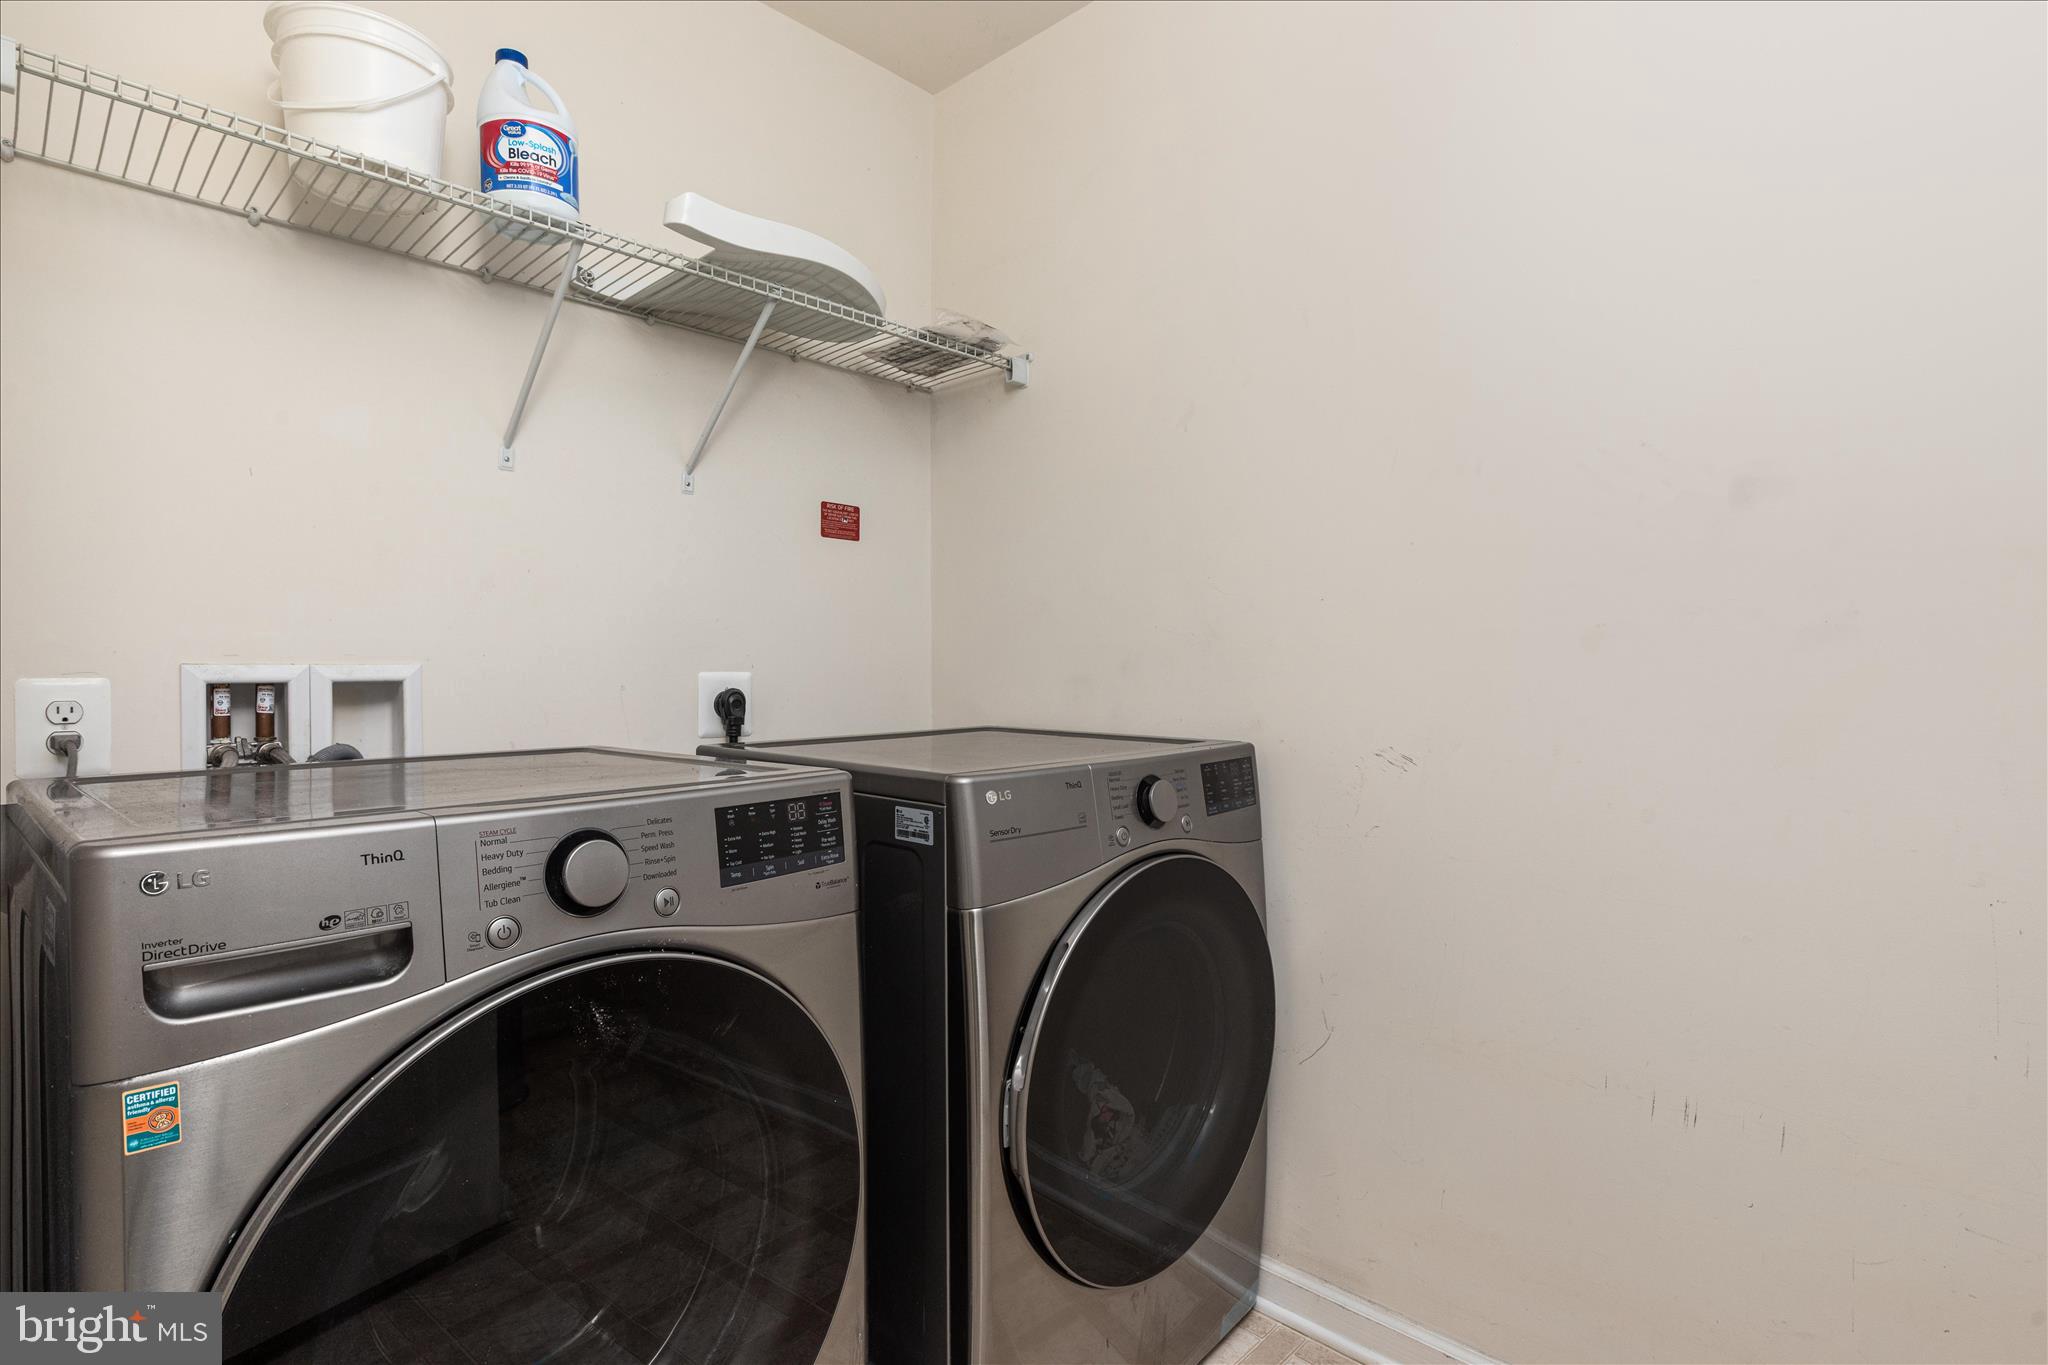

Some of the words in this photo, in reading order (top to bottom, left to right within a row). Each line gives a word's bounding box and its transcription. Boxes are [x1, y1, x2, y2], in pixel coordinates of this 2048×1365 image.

[508, 139, 557, 156] Low-Splash
[508, 148, 557, 168] Bleach
[1065, 780, 1082, 790] ThinQ
[999, 790, 1012, 800] LG
[647, 816, 673, 826] Delicates
[479, 828, 498, 838] STEAM
[500, 826, 517, 836] CYCLE
[658, 829, 674, 837] Press
[480, 837, 508, 848] Normal
[641, 844, 658, 853] Speed
[660, 841, 675, 850] Wash
[360, 850, 405, 866] ThinQ
[481, 852, 505, 862] Heavy
[506, 849, 524, 860] Duty
[482, 865, 512, 876] Bedding
[643, 870, 678, 881] Downloaded
[176, 870, 211, 890] LG
[484, 900, 498, 908] Tub
[500, 896, 521, 907] Clean
[141, 936, 184, 950] Inverter
[126, 1087, 176, 1104] CERTIFIED
[128, 1101, 150, 1110] asthma
[128, 1107, 151, 1116] friendly
